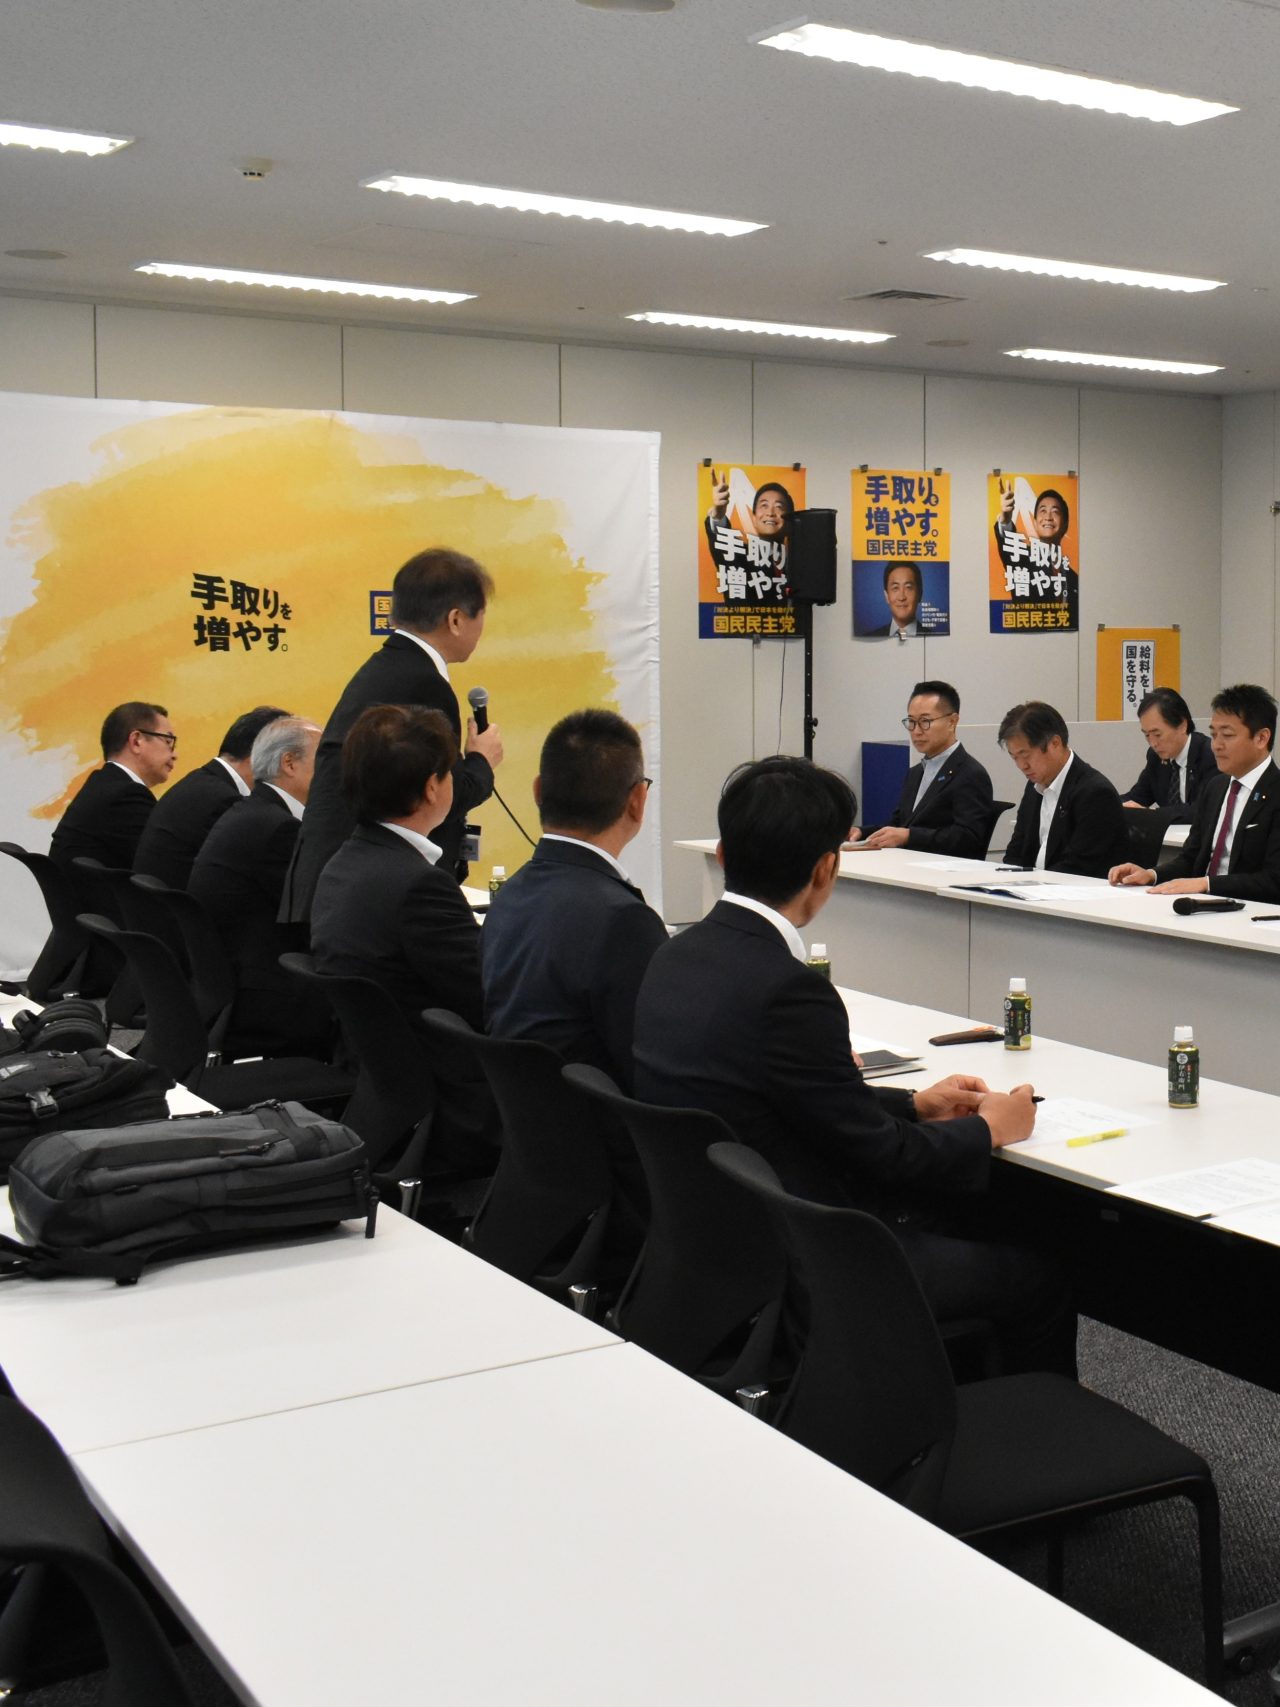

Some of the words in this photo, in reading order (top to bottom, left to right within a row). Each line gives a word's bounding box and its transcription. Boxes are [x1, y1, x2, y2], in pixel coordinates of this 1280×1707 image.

[865, 475, 939, 506] 手取り。
[865, 506, 939, 537] 増やす。
[714, 526, 786, 570] 手取り
[867, 539, 937, 556] 国民民主党
[1002, 530, 1071, 570] 手取りを
[190, 573, 292, 620] 手取りを
[1005, 565, 1068, 598] 増やす。
[374, 596, 393, 615] 国
[1002, 611, 1070, 628] 国民民主党
[193, 615, 289, 652] 増やす。
[713, 616, 795, 633] 国民民主党
[1126, 645, 1138, 708] 国を守る。
